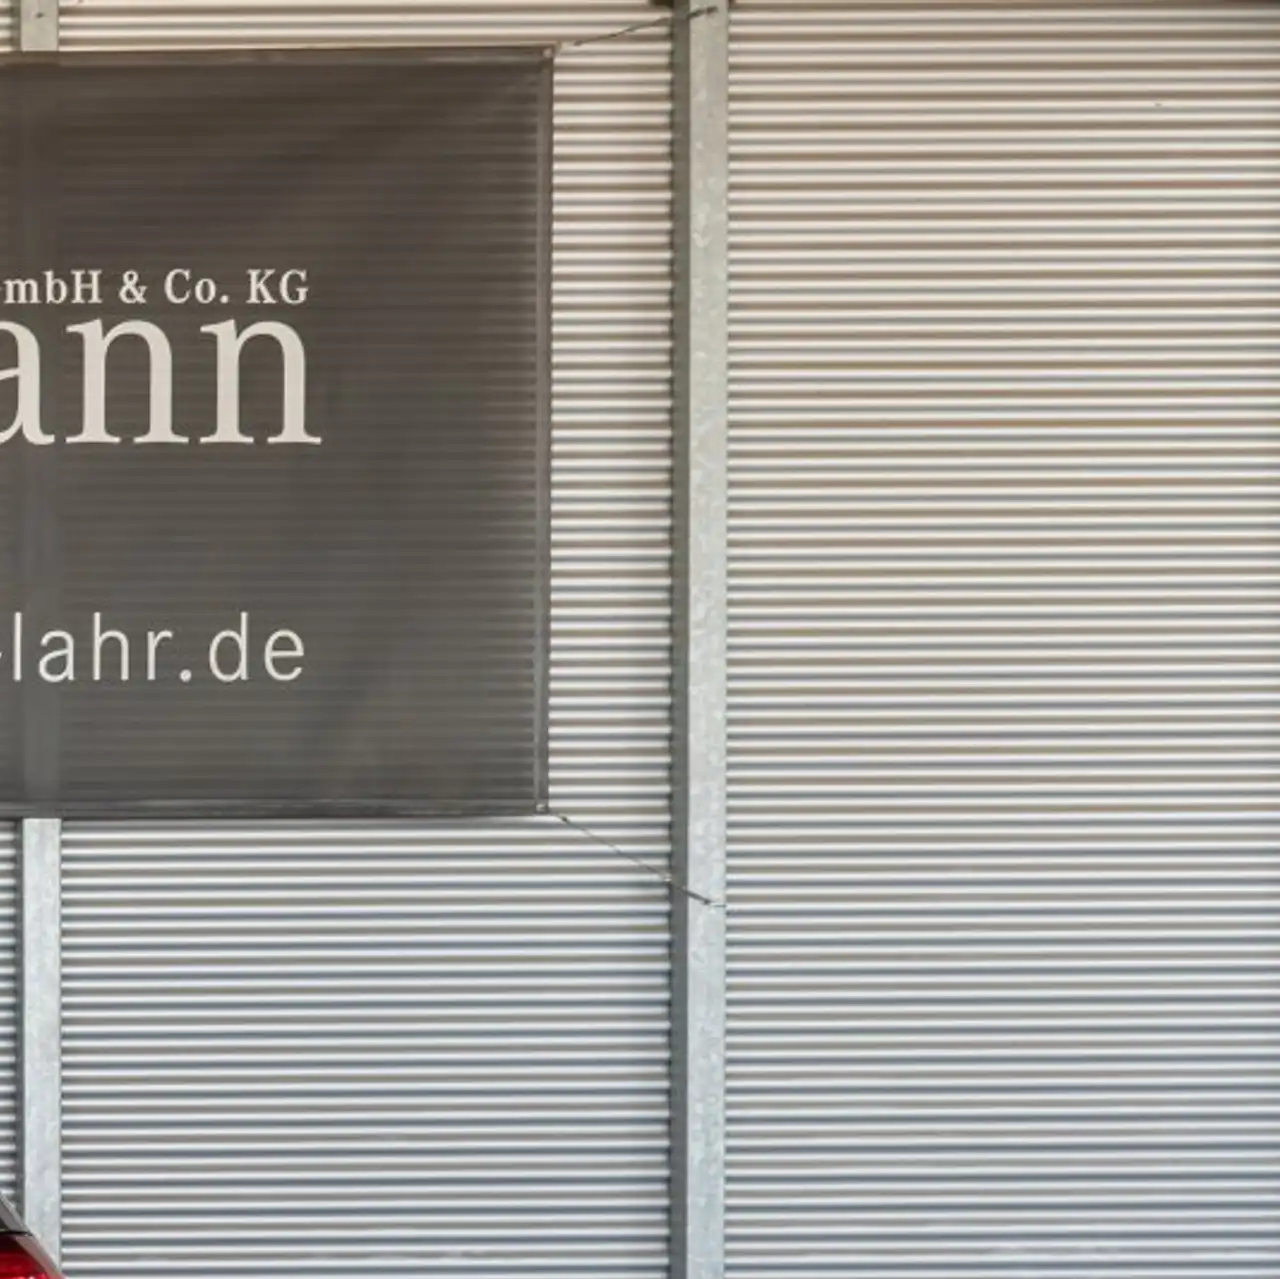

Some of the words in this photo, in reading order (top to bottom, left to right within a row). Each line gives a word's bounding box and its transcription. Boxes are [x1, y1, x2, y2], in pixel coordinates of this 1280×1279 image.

[119, 270, 147, 304] &
[164, 269, 229, 304] Co.
[247, 269, 309, 304] KG
